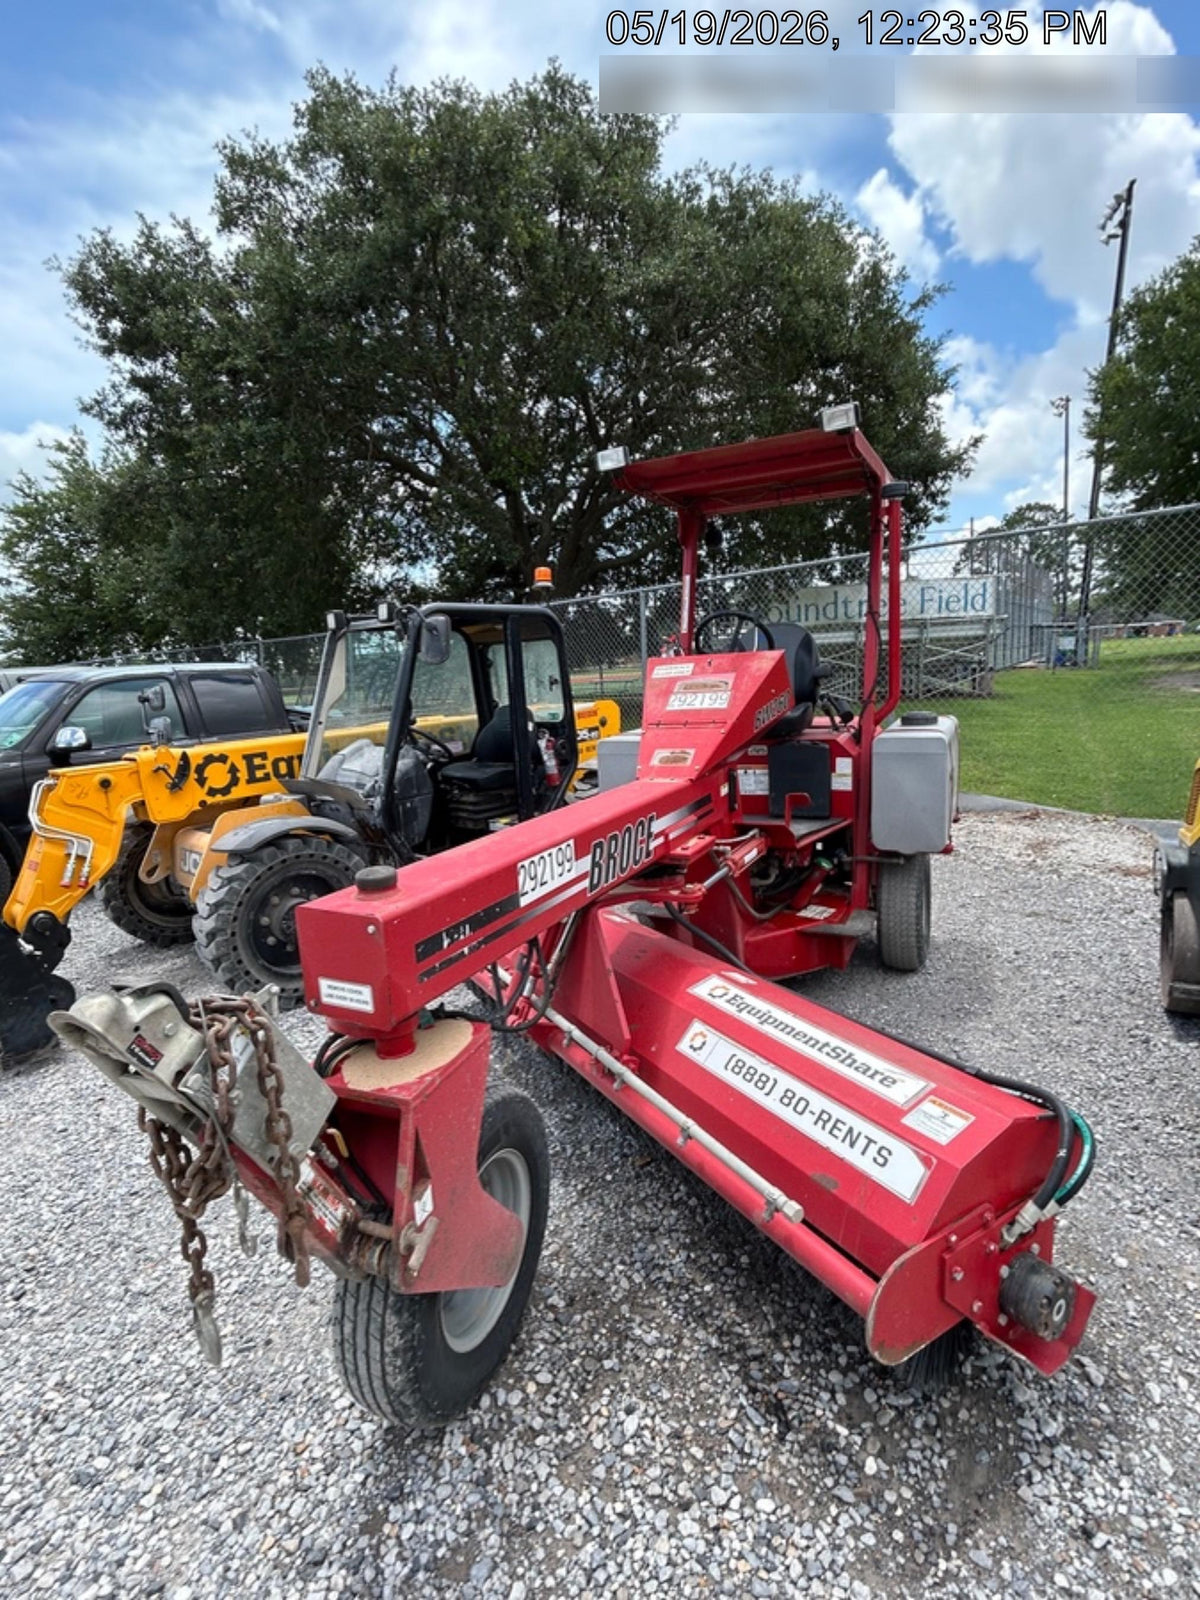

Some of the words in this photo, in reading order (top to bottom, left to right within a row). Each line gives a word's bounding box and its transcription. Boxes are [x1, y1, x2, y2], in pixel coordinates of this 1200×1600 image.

[920, 581, 987, 614] Field
[669, 691, 728, 708] 292199
[181, 850, 202, 874] JC
[518, 843, 573, 897] 292199
[587, 812, 657, 896] BROCE
[725, 993, 898, 1088] EquipmentShare
[724, 1053, 778, 1096] (888)
[780, 1088, 893, 1169] 80-RENTS
